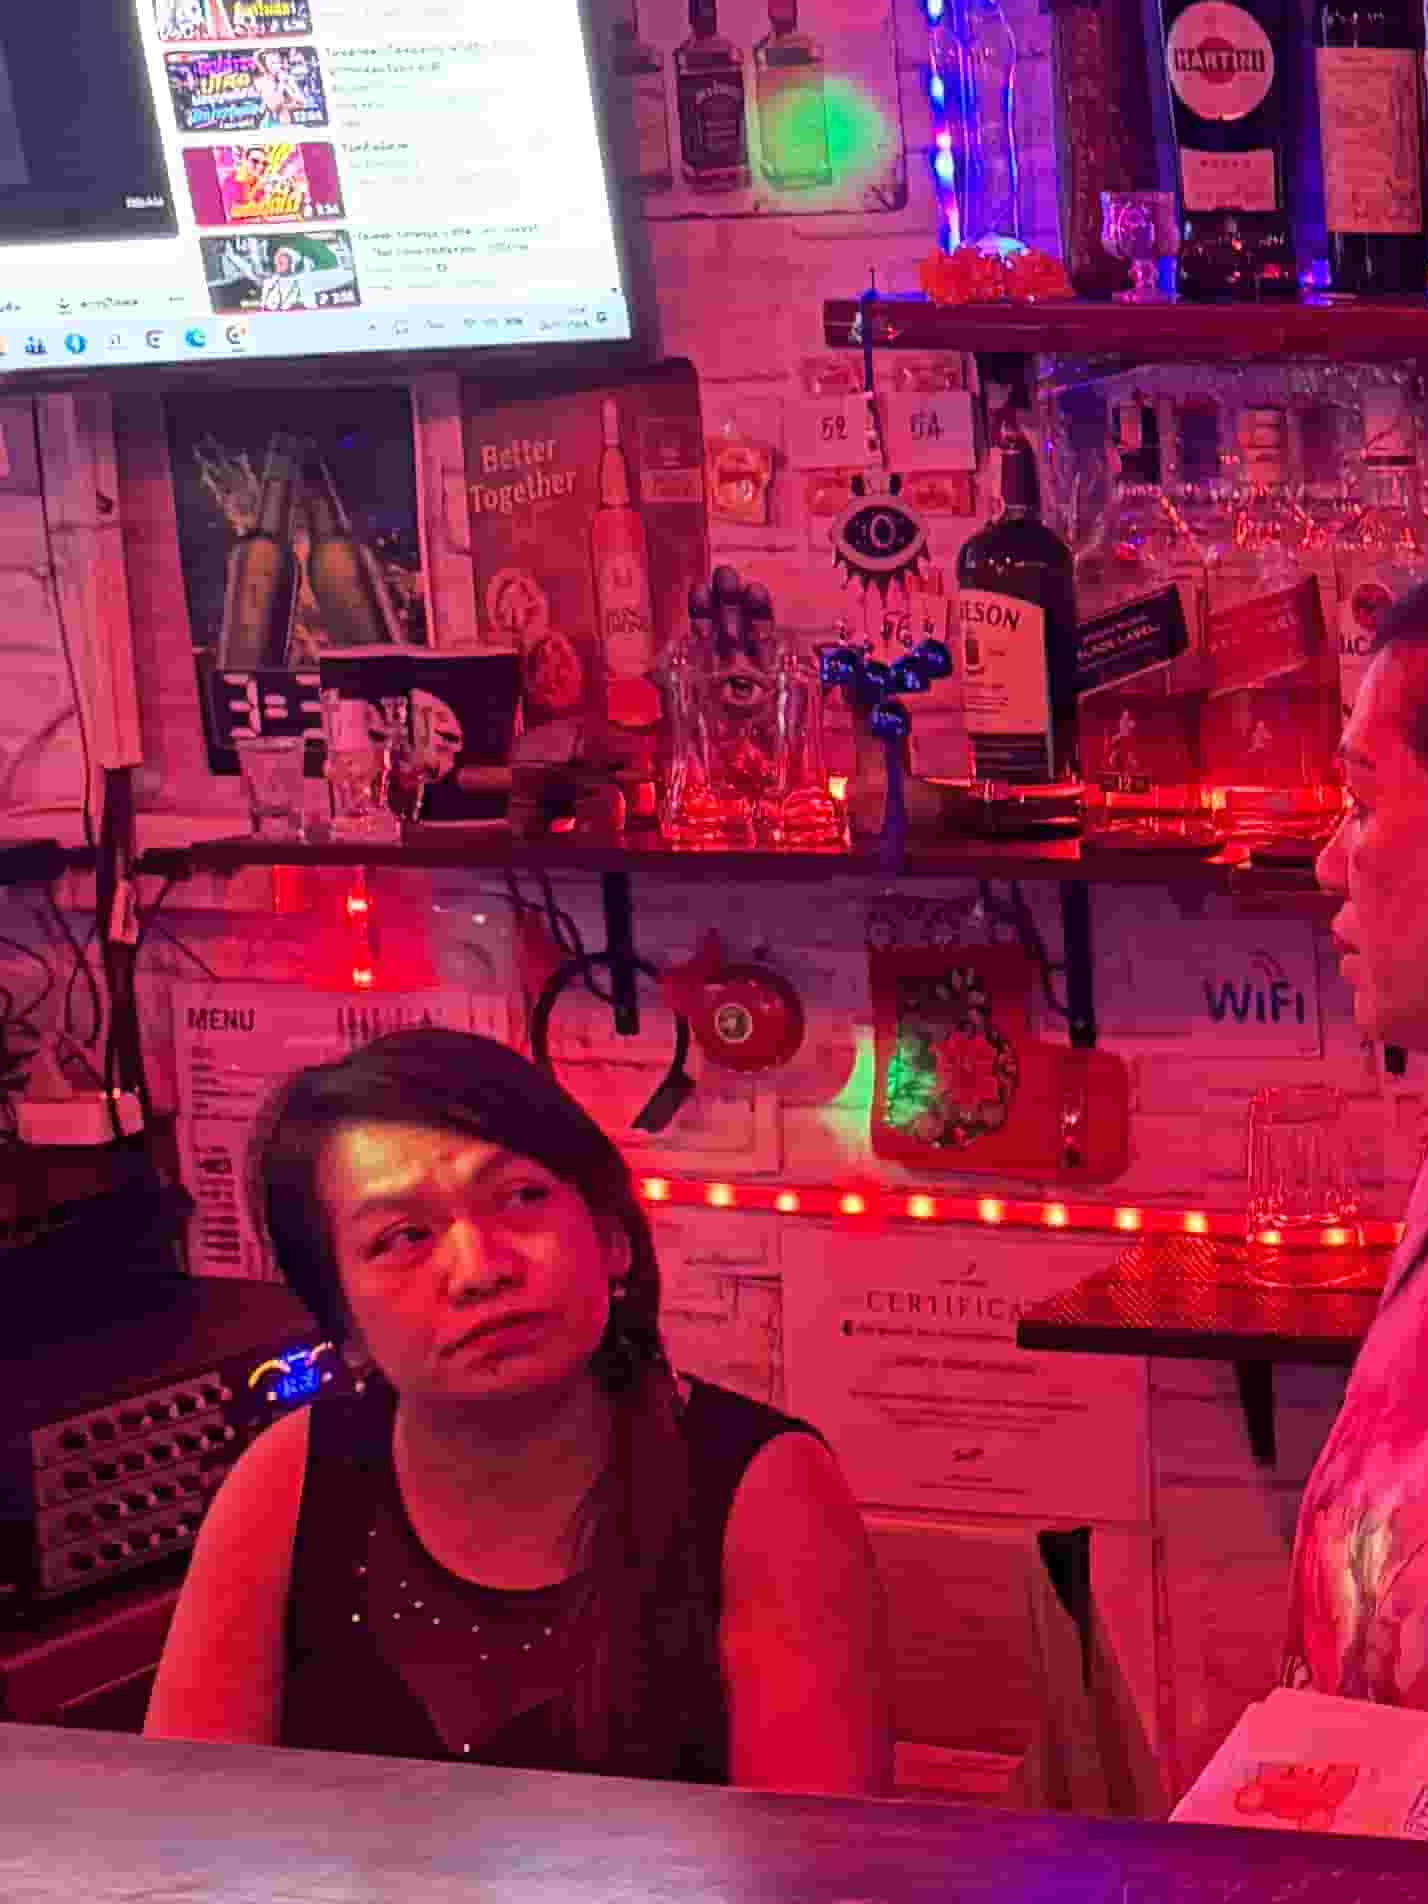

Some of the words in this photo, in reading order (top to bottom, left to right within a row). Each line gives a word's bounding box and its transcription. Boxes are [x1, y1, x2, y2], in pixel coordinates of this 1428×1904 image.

[481, 439, 557, 473] Better
[469, 471, 577, 515] Together
[187, 1006, 256, 1031] MENU
[866, 1289, 1024, 1321] CERTIFICA
